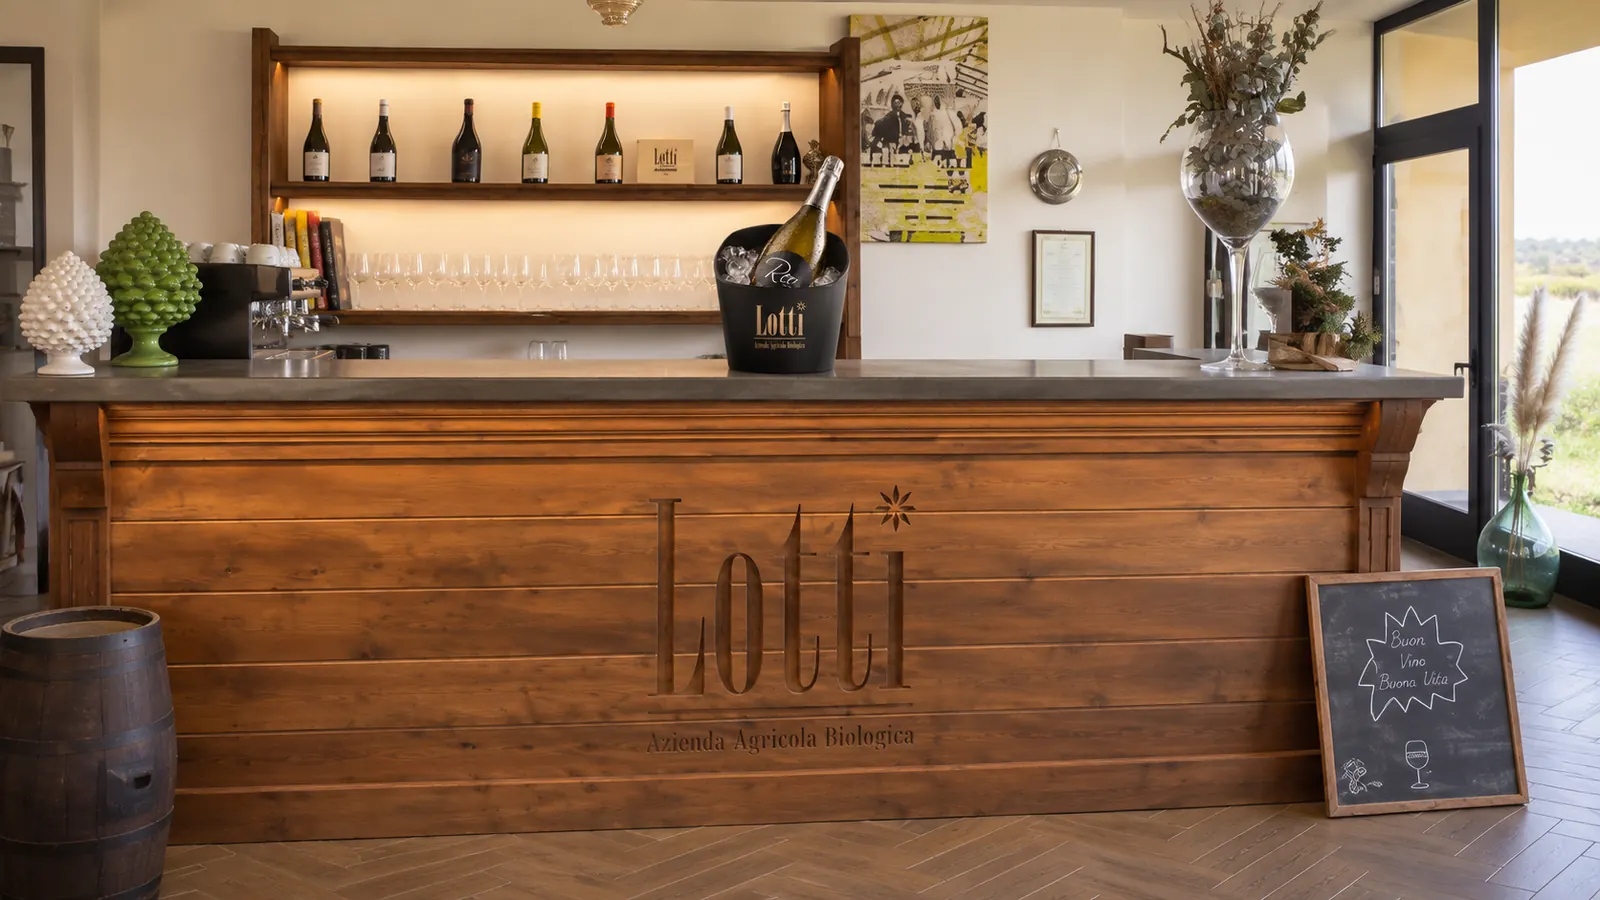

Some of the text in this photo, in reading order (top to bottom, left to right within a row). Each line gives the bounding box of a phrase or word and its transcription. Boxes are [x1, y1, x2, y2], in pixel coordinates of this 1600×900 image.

[755, 301, 806, 336] Lotti
[647, 484, 916, 696] Lotti
[1390, 629, 1426, 649] Buon
[1400, 653, 1426, 669] Vino
[1379, 671, 1448, 691] Buona Vita
[646, 723, 914, 754] Azienda Agricola Biologica
